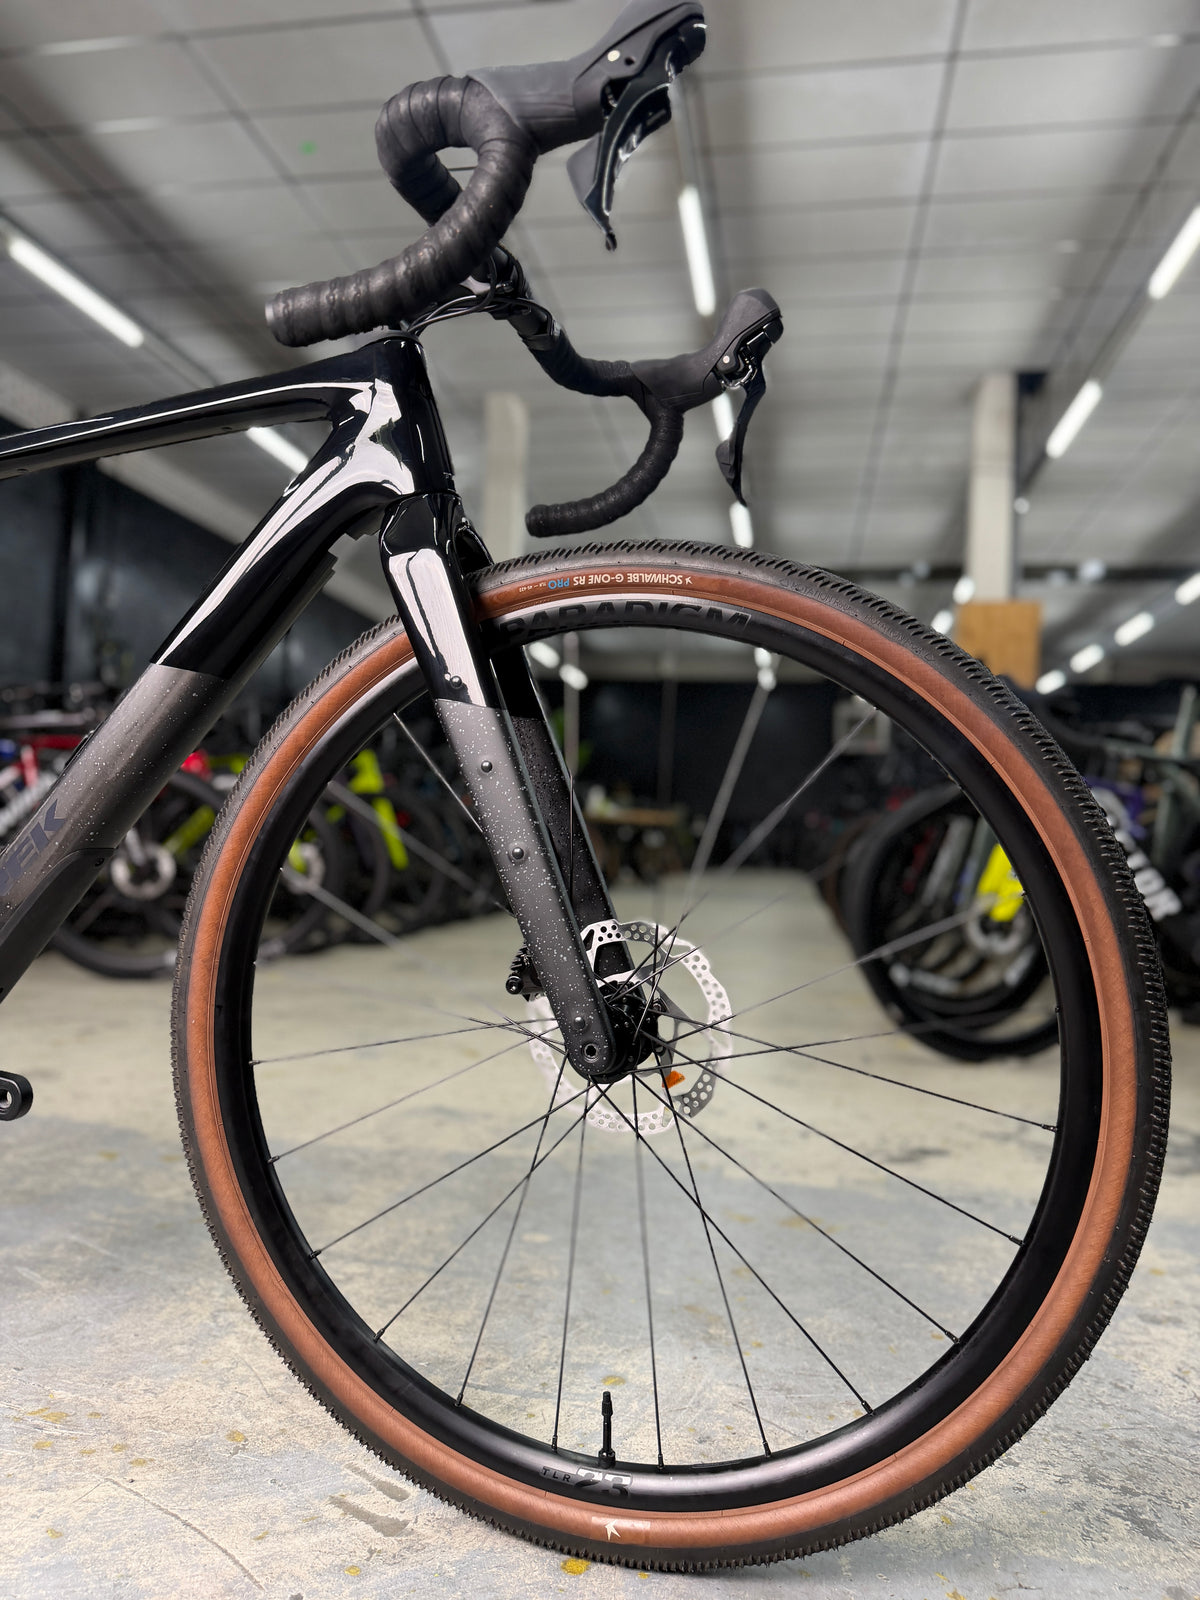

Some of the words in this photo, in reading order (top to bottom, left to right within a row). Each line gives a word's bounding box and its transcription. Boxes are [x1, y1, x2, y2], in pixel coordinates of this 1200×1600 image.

[548, 577, 570, 590] PRO
[573, 575, 586, 585] RS
[588, 573, 624, 584] G-ONE
[627, 572, 683, 585] SCHWALBE
[541, 1467, 571, 1482] TLR
